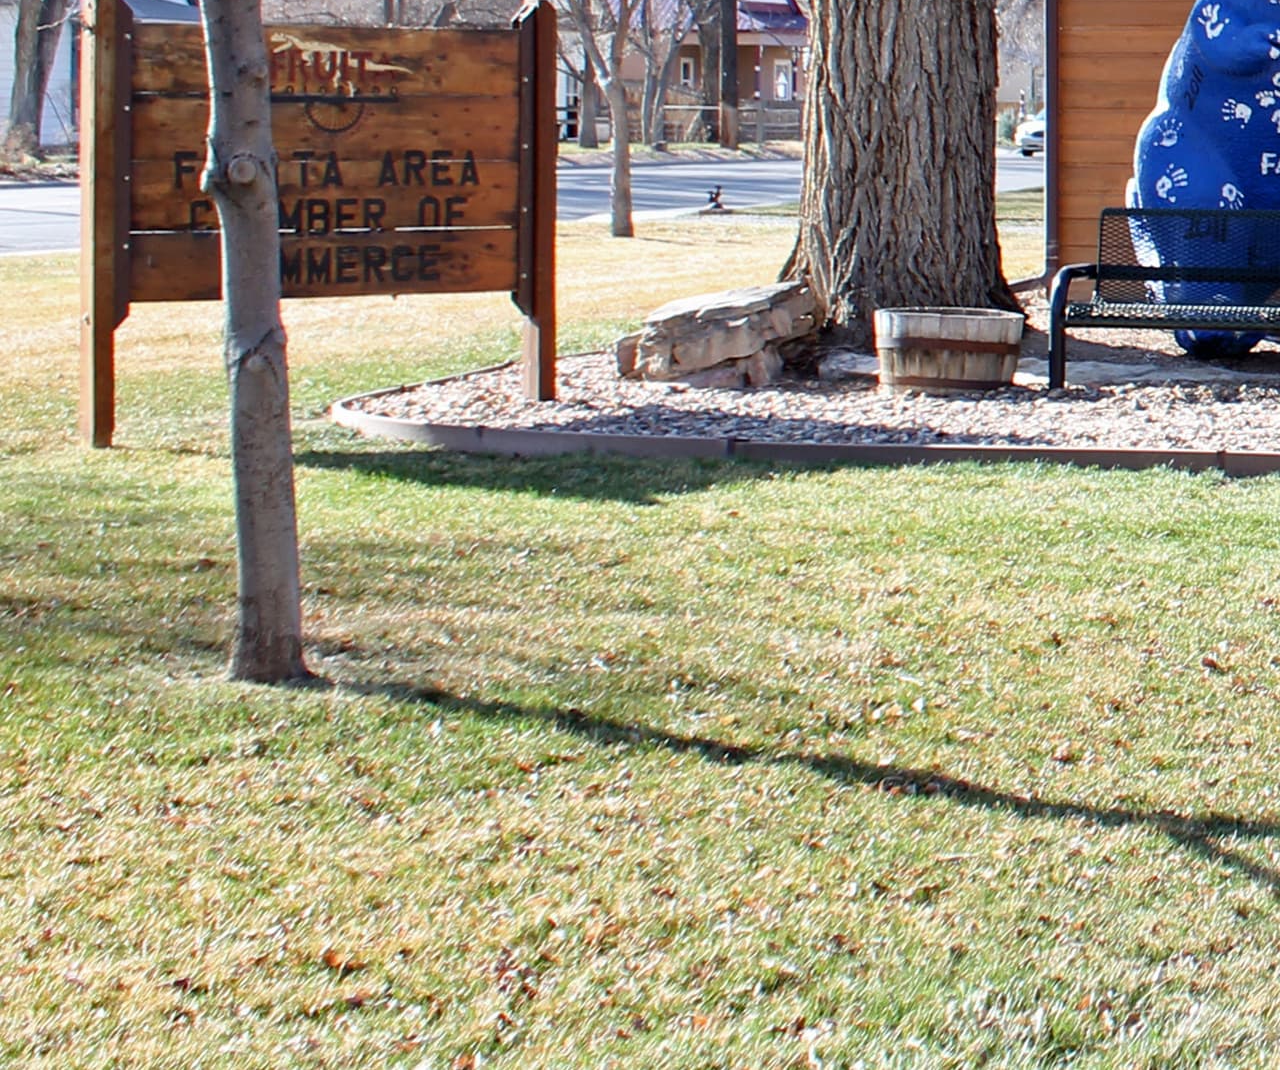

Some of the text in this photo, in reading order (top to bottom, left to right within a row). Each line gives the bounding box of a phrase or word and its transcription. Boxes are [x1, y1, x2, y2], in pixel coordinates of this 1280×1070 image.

[270, 50, 398, 83] FRUITA
[173, 149, 481, 190] FTA AREA
[188, 195, 469, 239] CMBER OF
[279, 244, 442, 285] MMERCE
